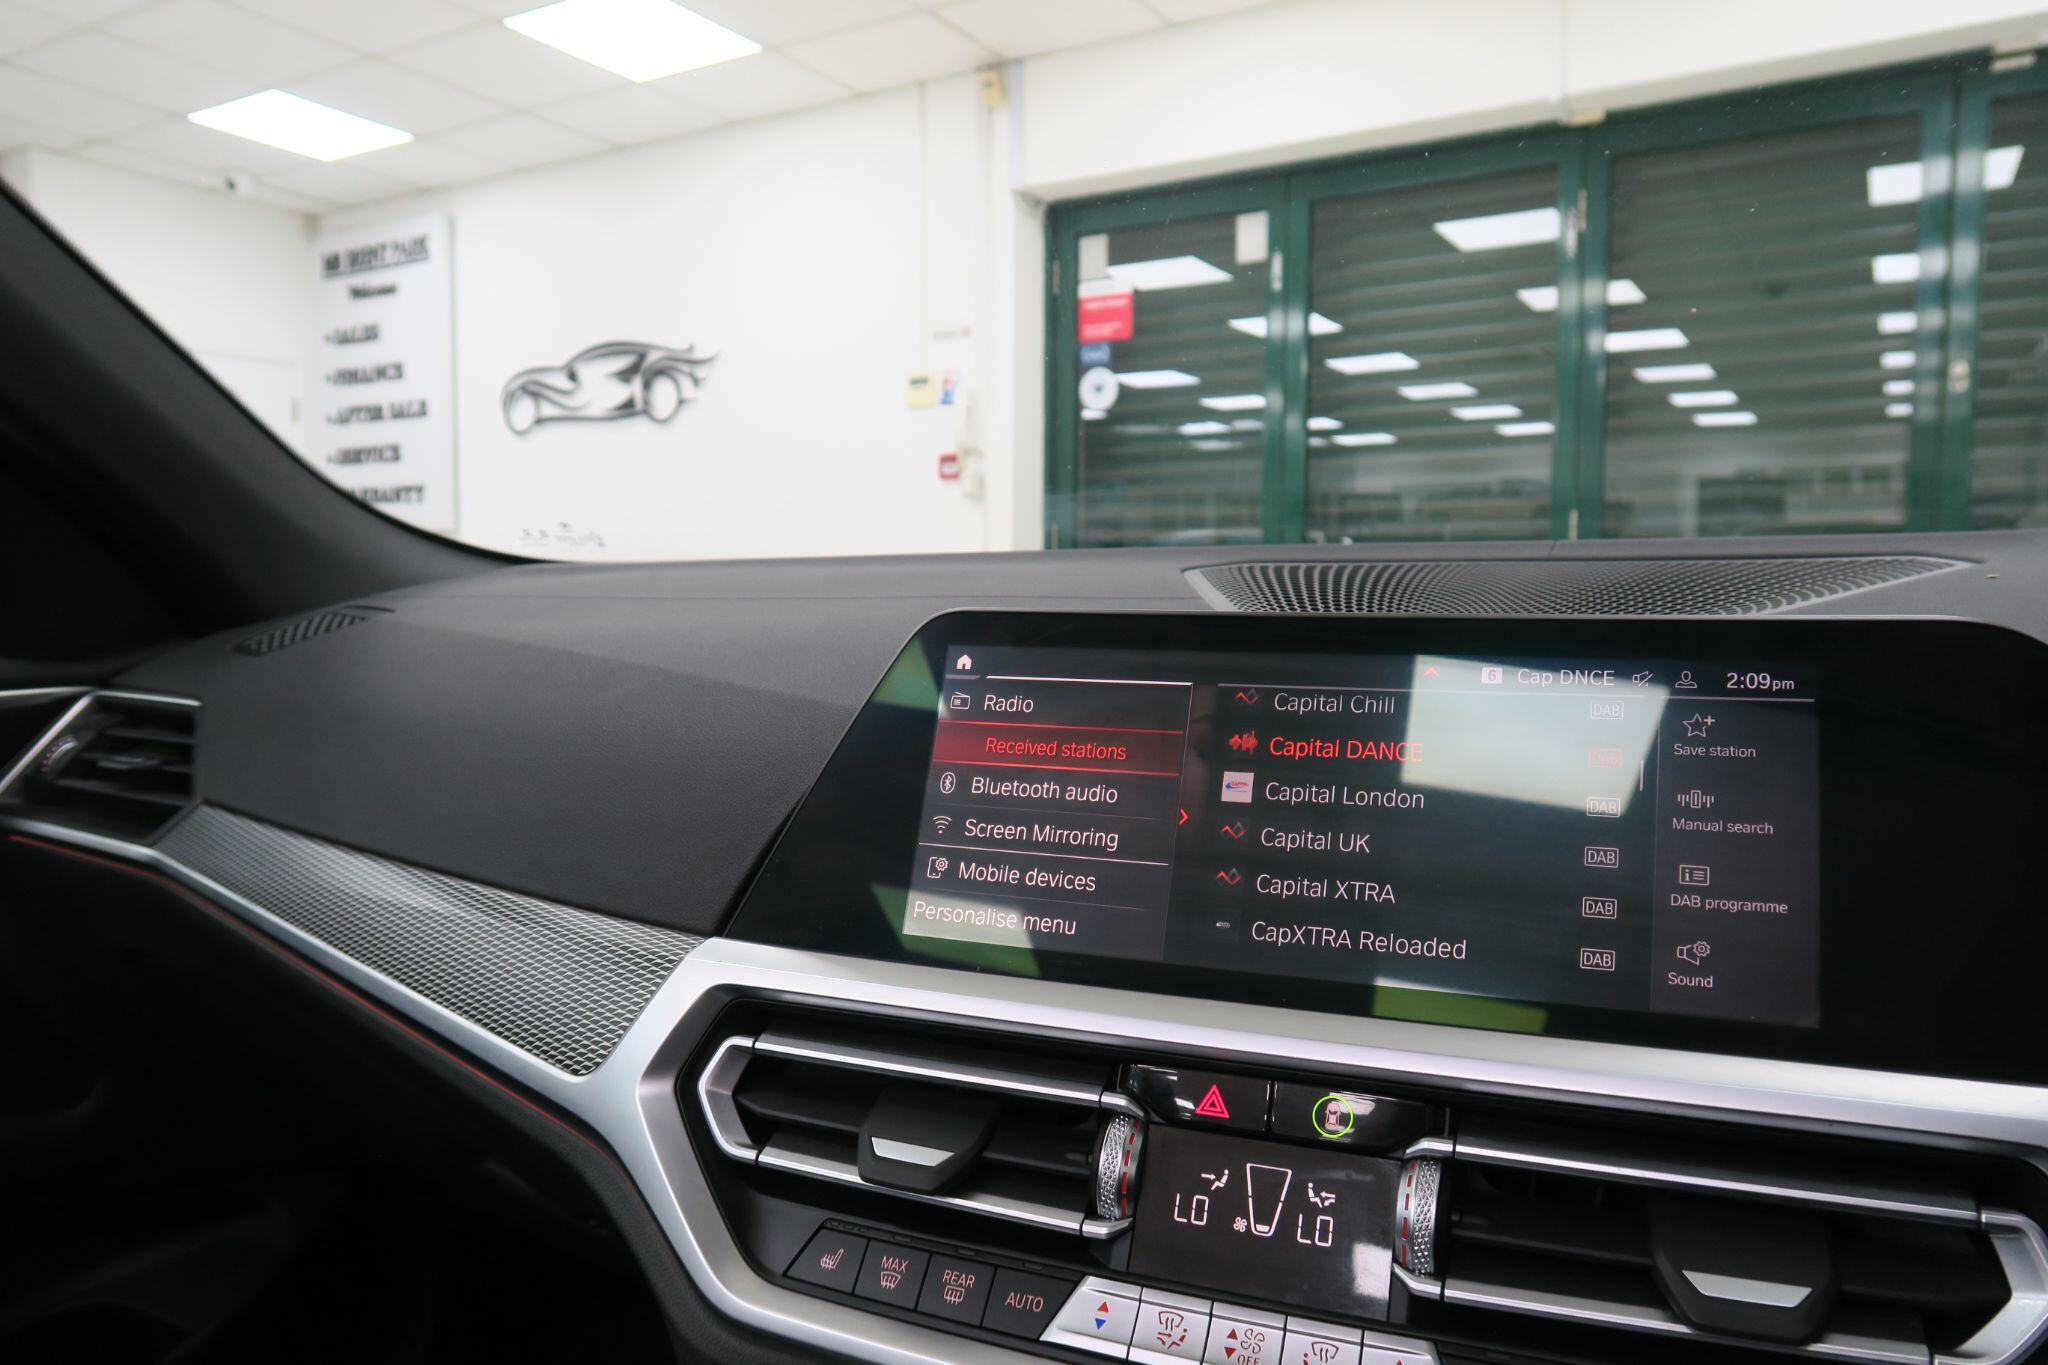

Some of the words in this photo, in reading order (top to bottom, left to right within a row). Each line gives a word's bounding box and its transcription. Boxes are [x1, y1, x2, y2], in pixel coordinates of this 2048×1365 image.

[1518, 668, 1553, 687] Cap
[1560, 669, 1616, 687] DNCE
[1726, 672, 1795, 692] 2:09pm
[984, 694, 1034, 713] Radio
[1274, 692, 1343, 715] Capital
[1350, 693, 1396, 714] Chill
[1593, 702, 1621, 718] DAB
[986, 737, 1058, 758] Received
[1062, 740, 1127, 761] stations
[1270, 736, 1340, 761] Capital
[1347, 740, 1424, 763] DANCE
[1674, 743, 1706, 758] Save
[1709, 744, 1757, 759] station
[971, 776, 1061, 801] Bluetooth
[1065, 782, 1119, 804] audio
[1265, 782, 1336, 806] Capital
[1343, 786, 1425, 809] London
[1589, 799, 1618, 815] DAB
[964, 819, 1027, 842] Screen
[1032, 823, 1119, 852] Mirroring
[1672, 817, 1723, 833] Manual
[1727, 821, 1774, 835] search
[1261, 828, 1331, 852] Capital
[1339, 832, 1371, 853] UK
[1587, 850, 1616, 865] DAB
[958, 862, 1020, 885] Mobile
[1025, 866, 1097, 892] devices
[1256, 874, 1327, 899] Capital
[1335, 881, 1396, 904] XTRA
[1585, 900, 1615, 916] DAB
[1671, 893, 1701, 908] DAB
[1705, 896, 1789, 914] programme
[913, 900, 1018, 930] Personalise
[1023, 913, 1077, 935] menu
[1252, 921, 1352, 949] CapXTRA
[1360, 931, 1467, 960] Reloaded
[1583, 951, 1613, 967] DAB
[1668, 971, 1714, 988] Sound
[880, 1255, 910, 1274] MAX
[942, 1269, 976, 1289] REAR
[1004, 1291, 1044, 1313] AUTO
